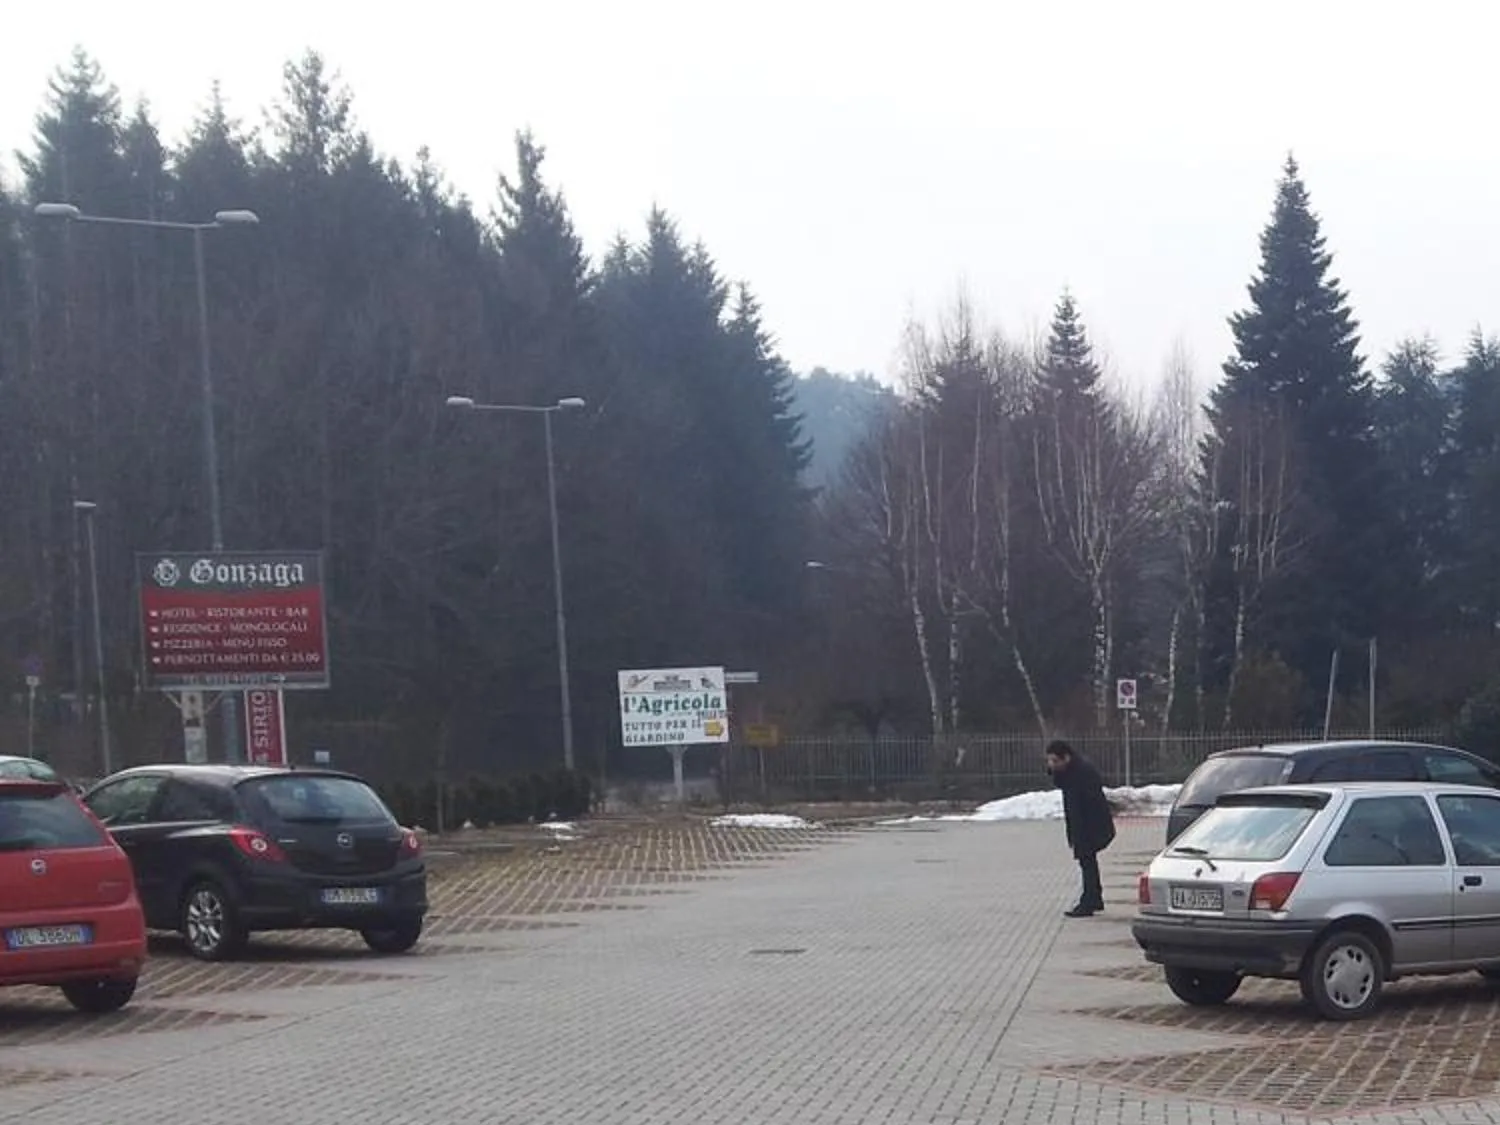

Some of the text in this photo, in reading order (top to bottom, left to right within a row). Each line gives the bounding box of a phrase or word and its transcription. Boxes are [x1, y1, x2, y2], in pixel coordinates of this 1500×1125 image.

[190, 558, 304, 588] Gonzaga
[161, 606, 309, 618] HOTEL RISTORANTE BAR
[163, 622, 308, 634] RESIDENCE MONOLOCALI
[163, 639, 214, 650] PIZZERIA
[164, 654, 259, 665] PERNOTTAMENTI
[623, 692, 721, 717] l'Agricola
[251, 691, 268, 748] SIRIO
[624, 720, 662, 732] TUTTO
[666, 719, 687, 730] PER
[625, 732, 685, 743] GIARDINO
